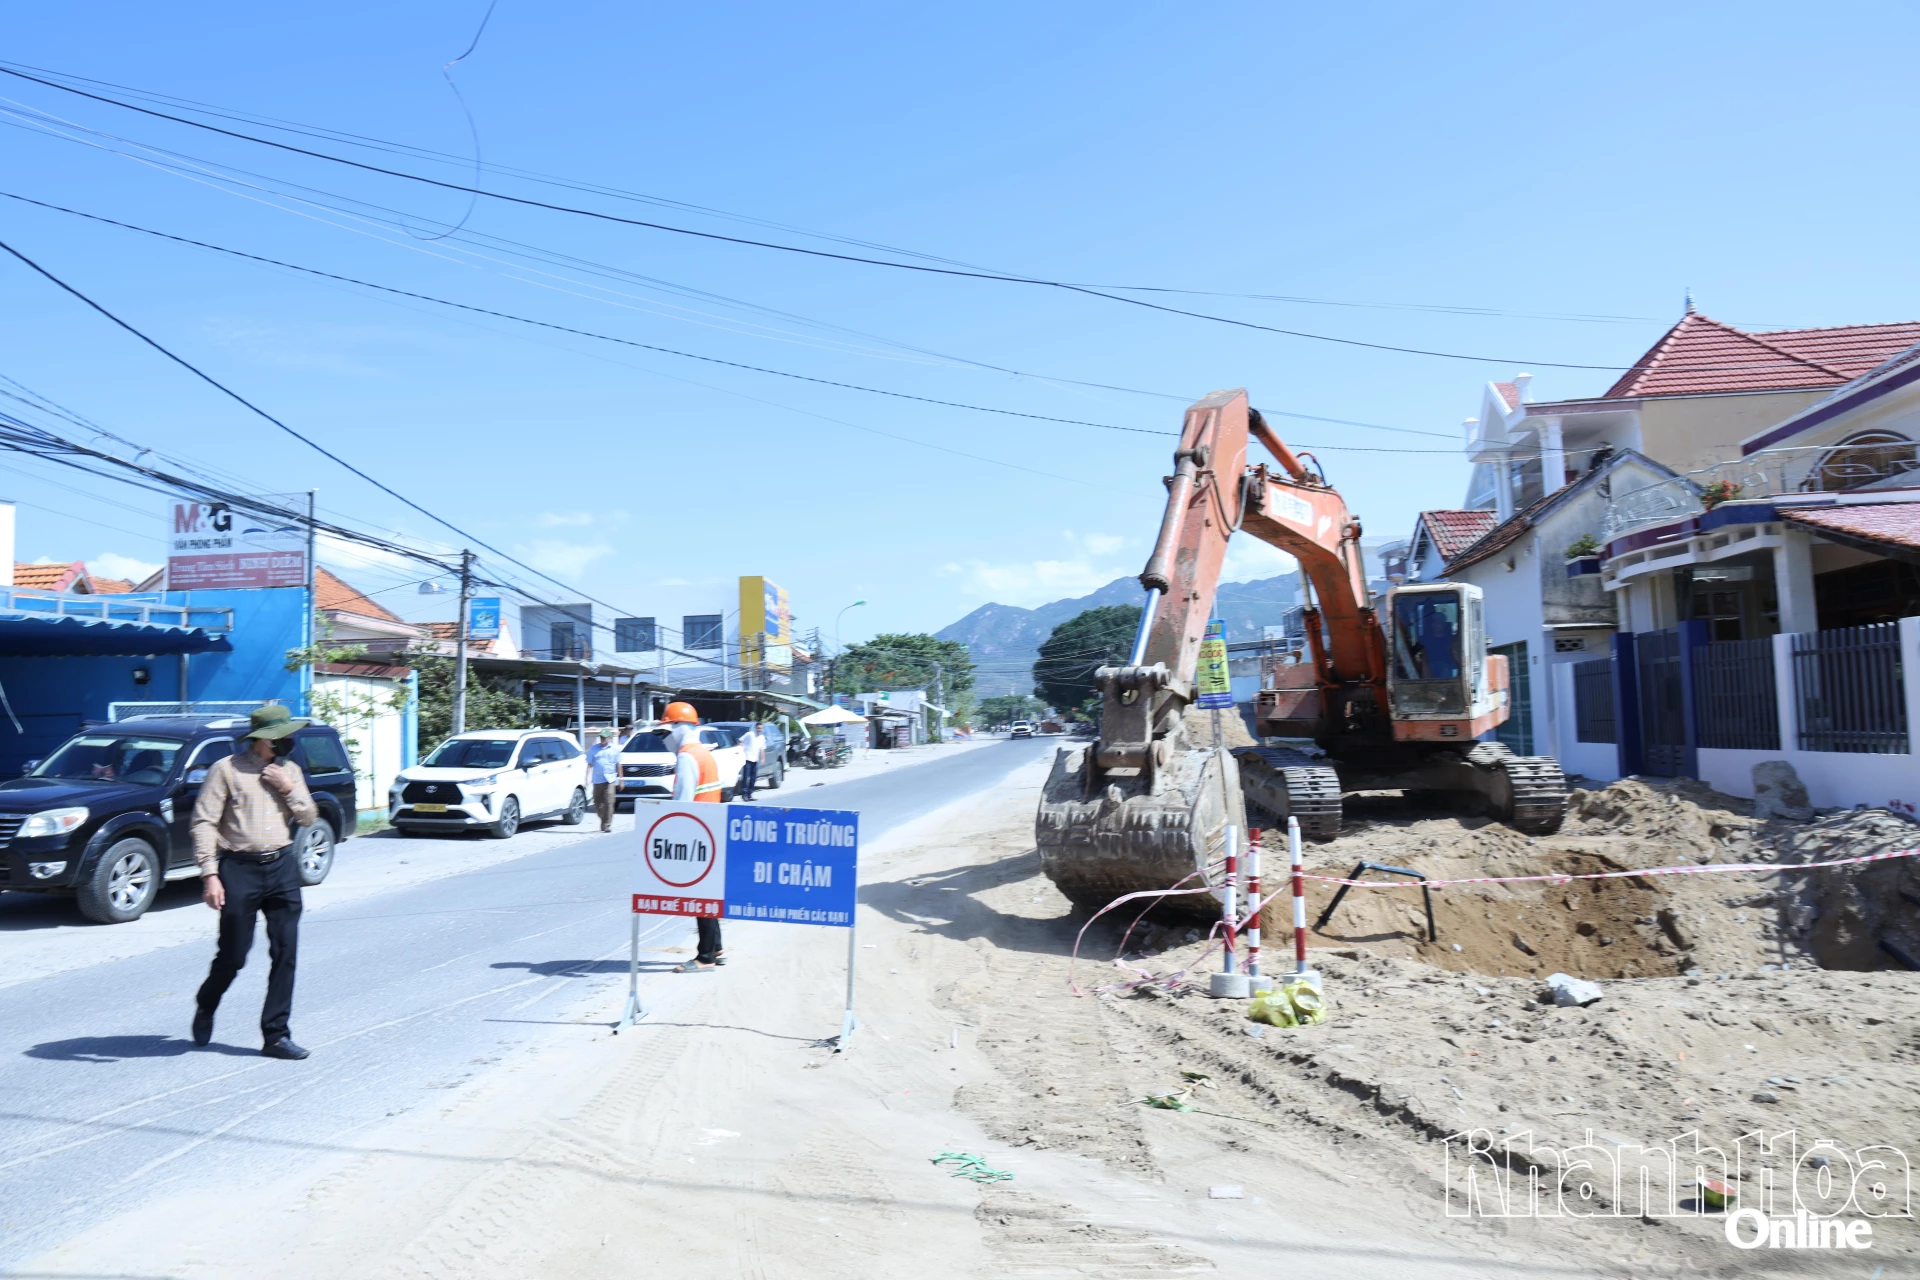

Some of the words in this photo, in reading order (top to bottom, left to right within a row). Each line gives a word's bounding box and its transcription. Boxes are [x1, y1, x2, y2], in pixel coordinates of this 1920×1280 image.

[174, 502, 232, 533] M&G
[729, 815, 778, 842] CÔNG
[784, 818, 855, 847] TRƯỜNG
[653, 838, 707, 862] 5km/h
[753, 861, 772, 884] ĐI
[778, 860, 832, 892] CHẬM
[637, 898, 658, 911] HẠN
[660, 898, 680, 911] CHẾ
[682, 899, 702, 913] TỐC
[811, 908, 827, 922] CÁC
